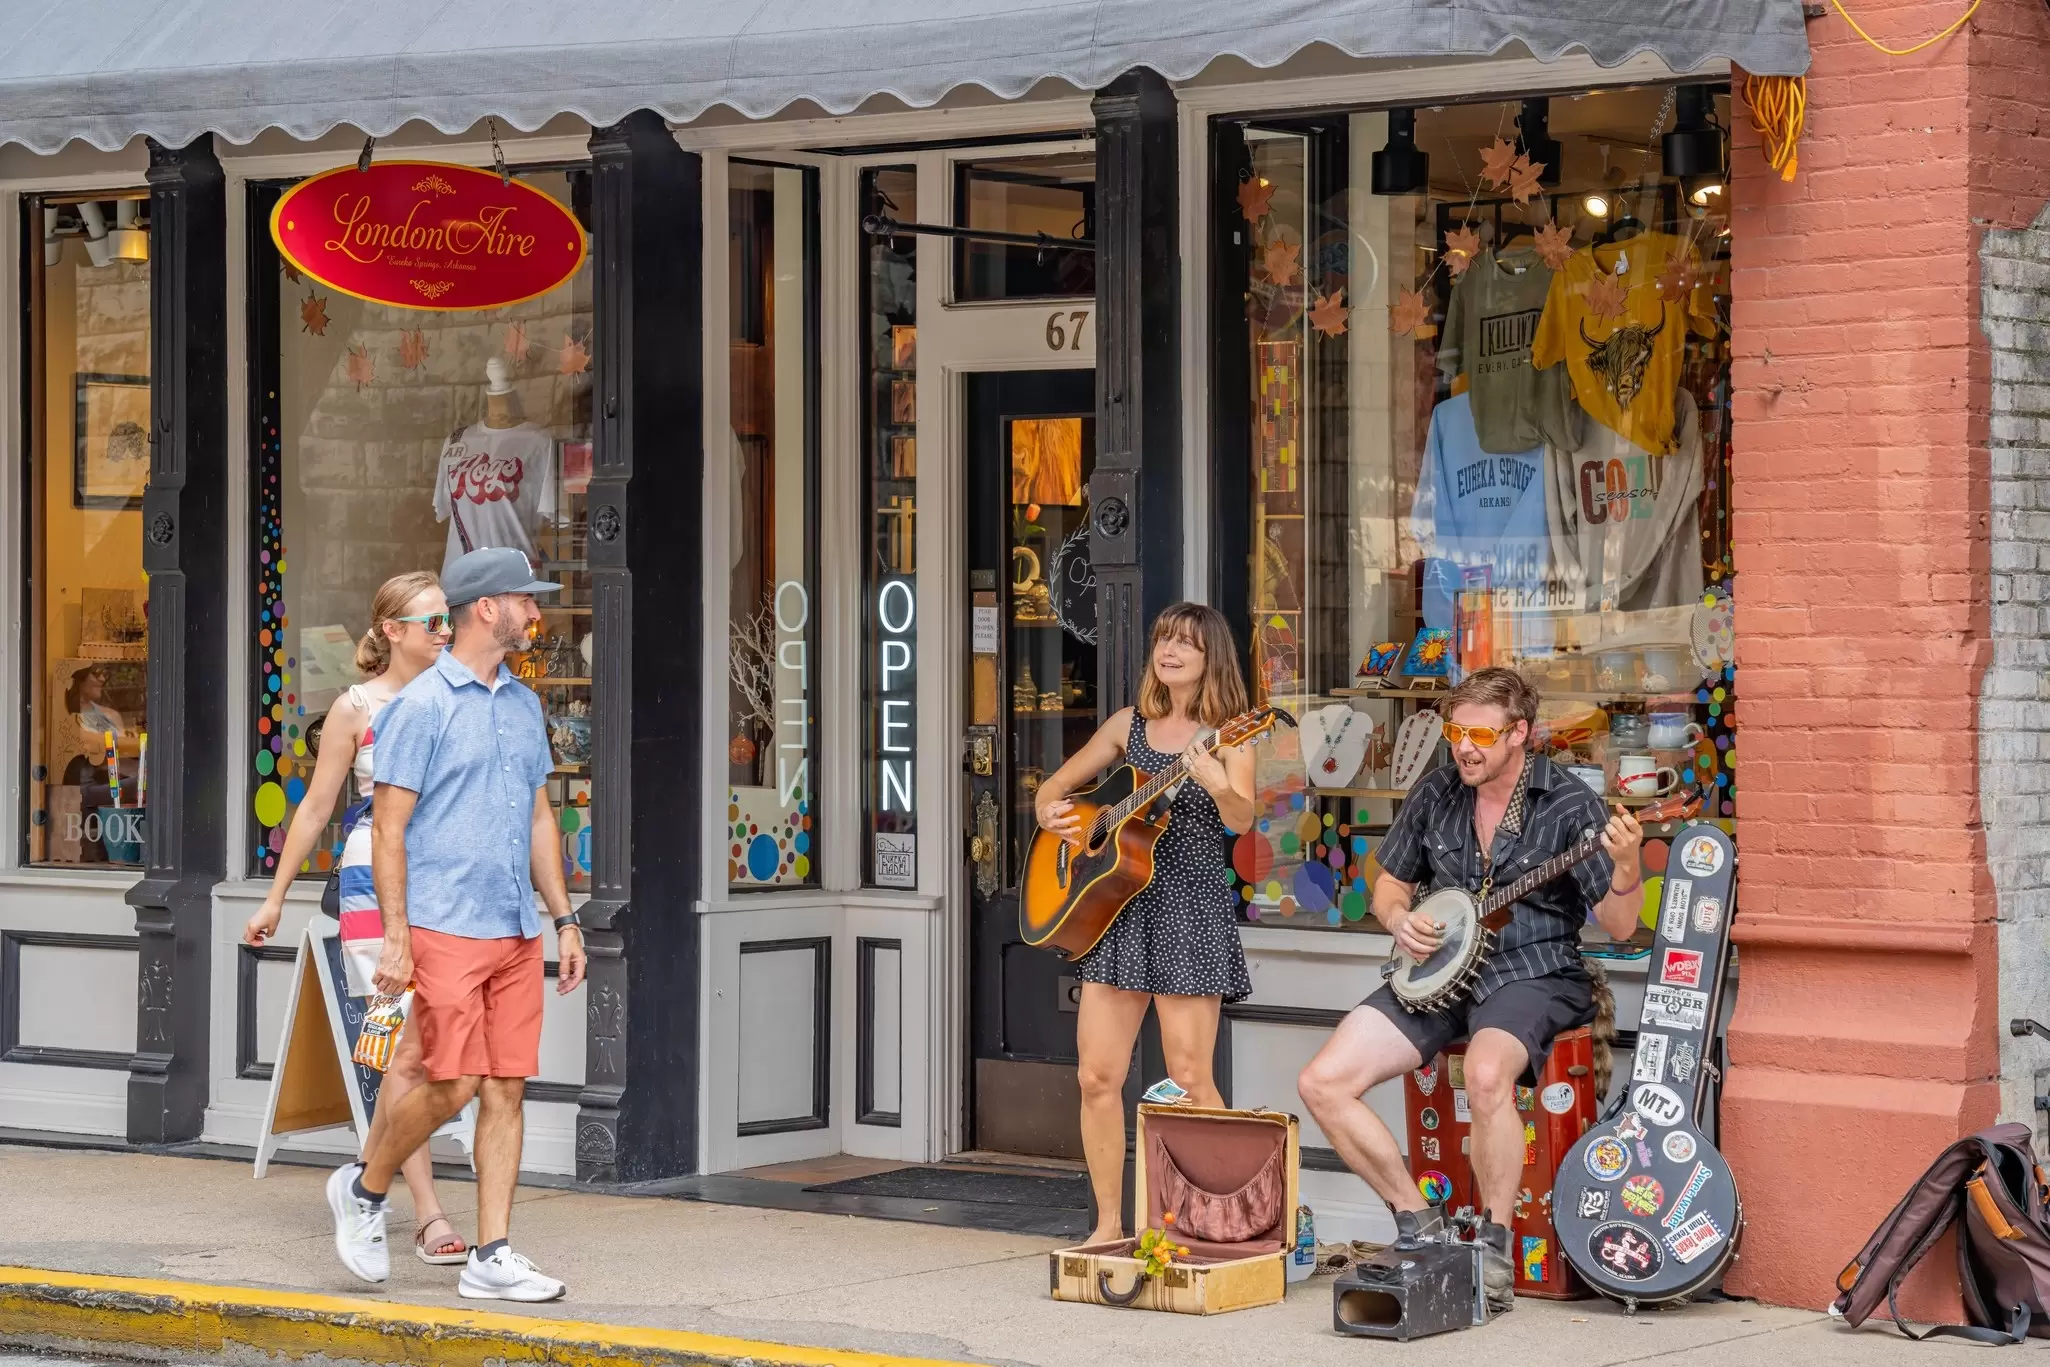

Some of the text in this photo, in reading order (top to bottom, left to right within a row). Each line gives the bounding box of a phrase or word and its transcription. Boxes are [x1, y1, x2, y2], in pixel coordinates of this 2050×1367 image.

[325, 193, 535, 263] London Aire
[386, 255, 412, 267] Eureka
[443, 259, 477, 271] Arkansas
[1046, 311, 1089, 351] 67
[448, 452, 523, 505] Hogs
[1457, 458, 1497, 499] EUREKA
[879, 580, 914, 812] OPEN
[63, 812, 145, 843] BOOK
[1665, 960, 1701, 973] WDBX
[1638, 1088, 1680, 1120] MTJ
[1669, 1166, 1712, 1228] Sweetwater
[1668, 1227, 1688, 1245] Texas
[1688, 1216, 1707, 1230] Than
[1694, 1223, 1715, 1241] More
[1674, 1236, 1699, 1255] Texas
